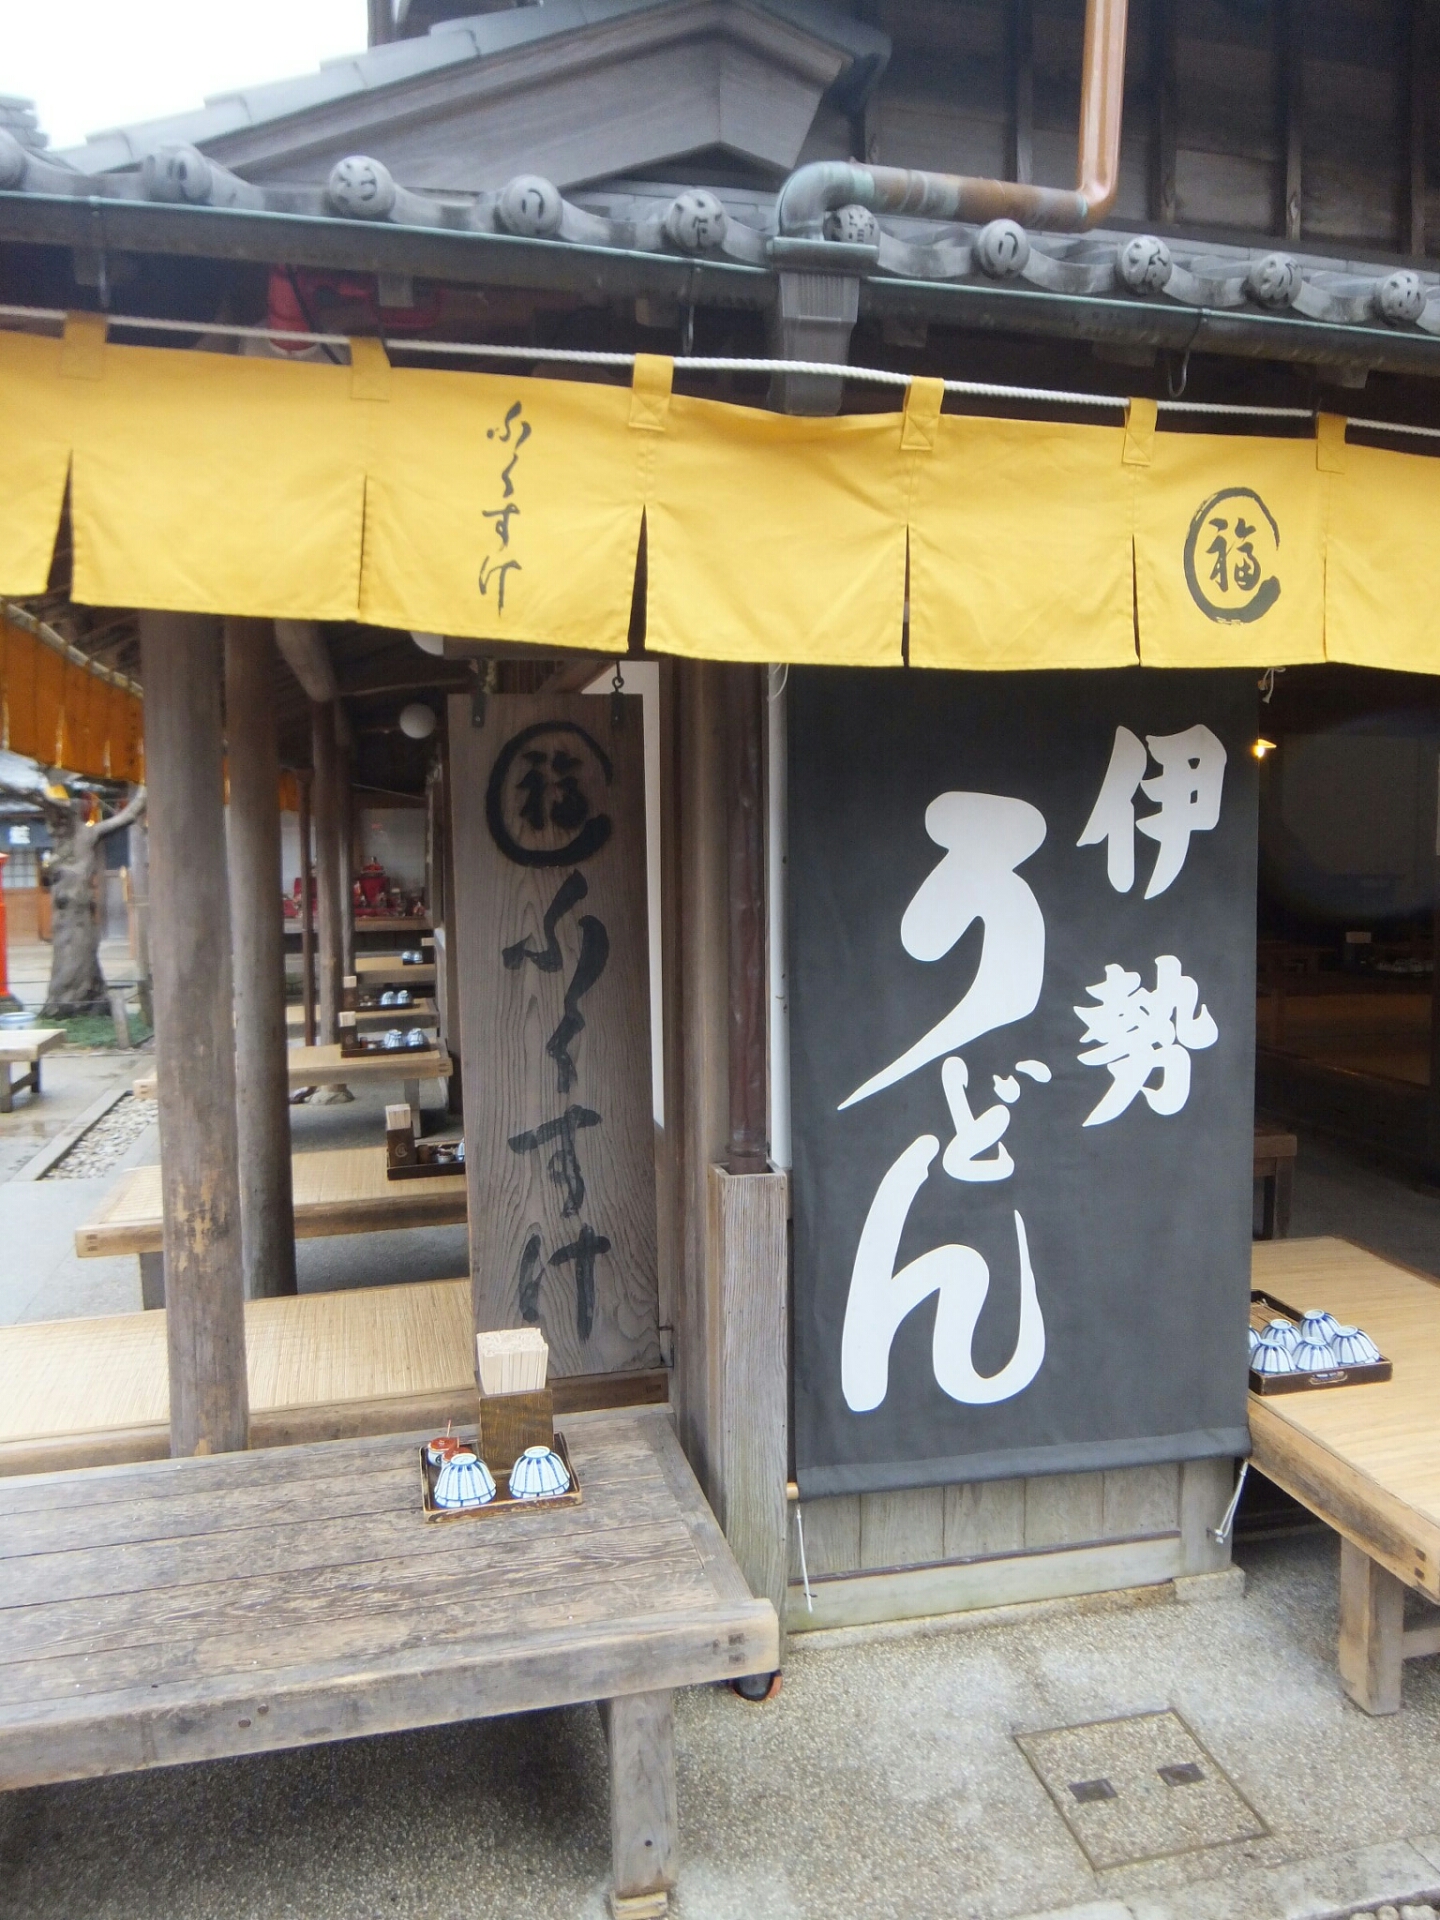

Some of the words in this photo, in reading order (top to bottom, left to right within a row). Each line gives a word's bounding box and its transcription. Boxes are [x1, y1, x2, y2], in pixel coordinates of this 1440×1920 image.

[479, 400, 532, 618] ふくすけ
[502, 868, 612, 1343] ふくすけ
[836, 791, 1053, 1413] うどん
[1072, 723, 1229, 1128] 伊勢
